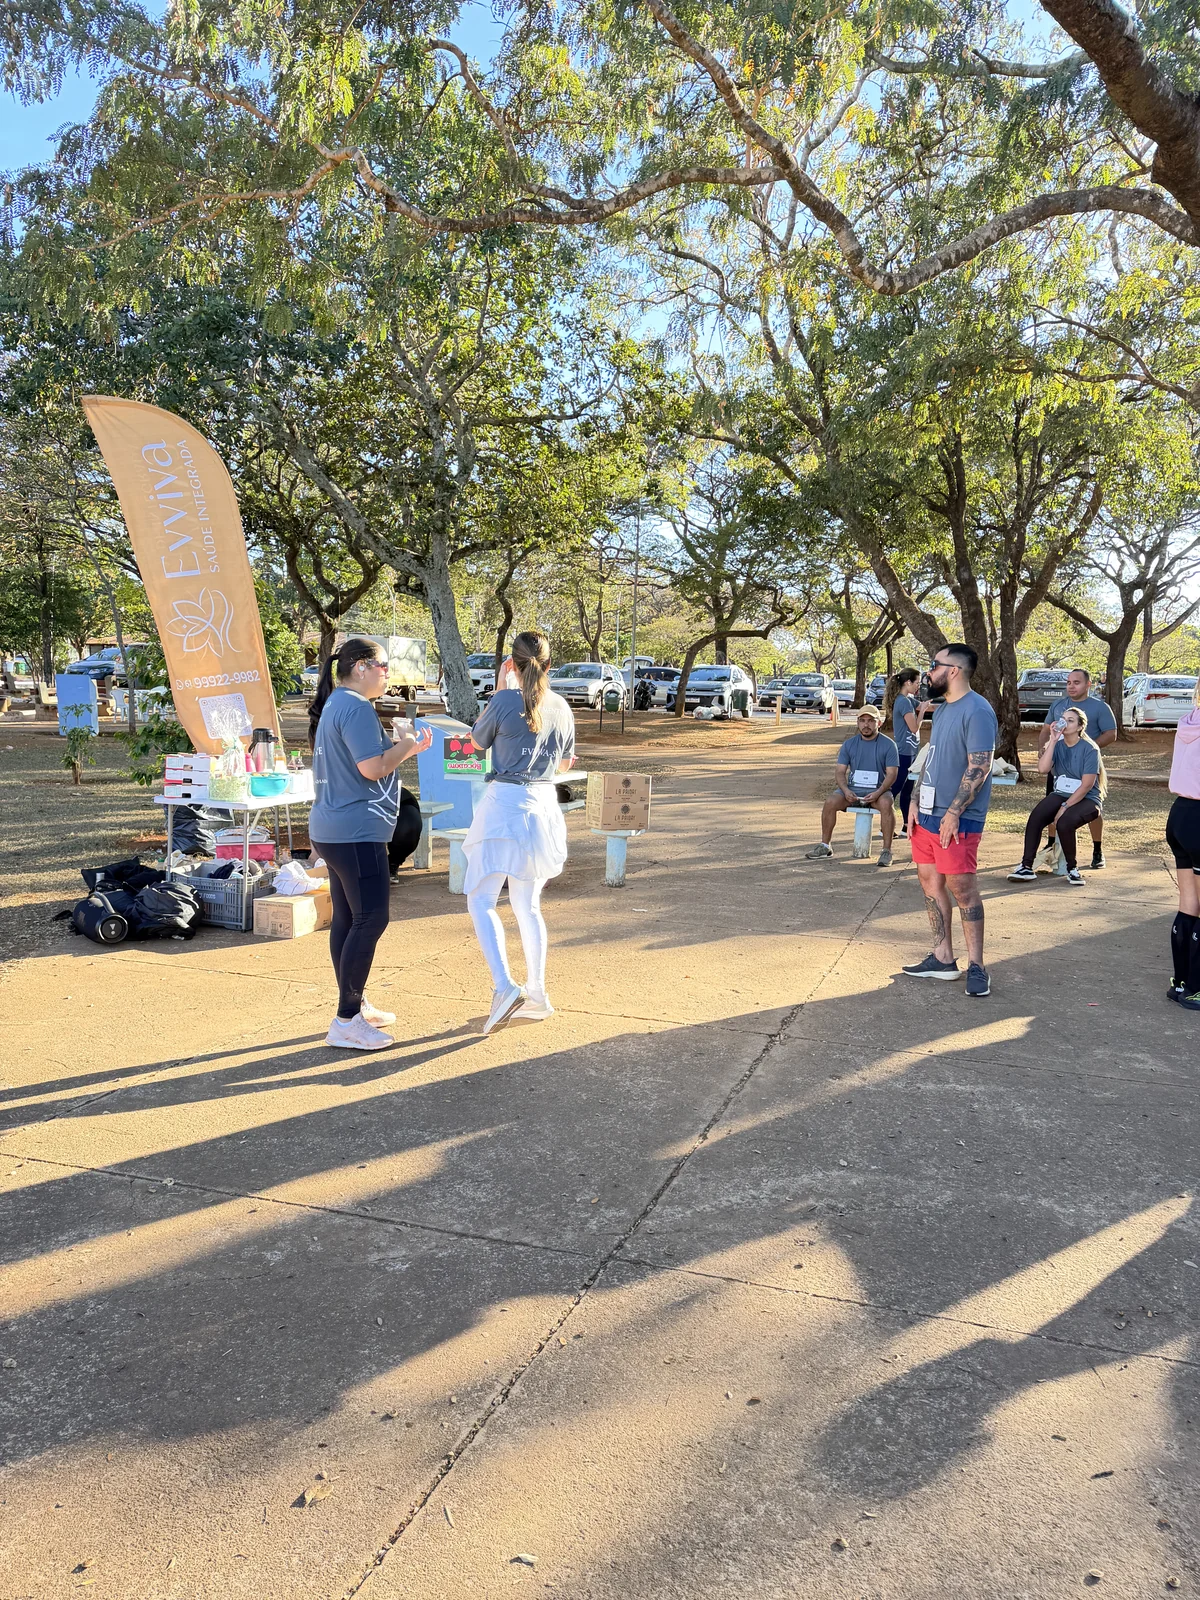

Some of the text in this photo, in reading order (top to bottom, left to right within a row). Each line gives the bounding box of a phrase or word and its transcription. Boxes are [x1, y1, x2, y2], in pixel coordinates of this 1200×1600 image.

[141, 438, 201, 578] Evviva
[176, 440, 220, 573] SAÚDE INTEGRADA
[194, 670, 260, 688] 99922-9982
